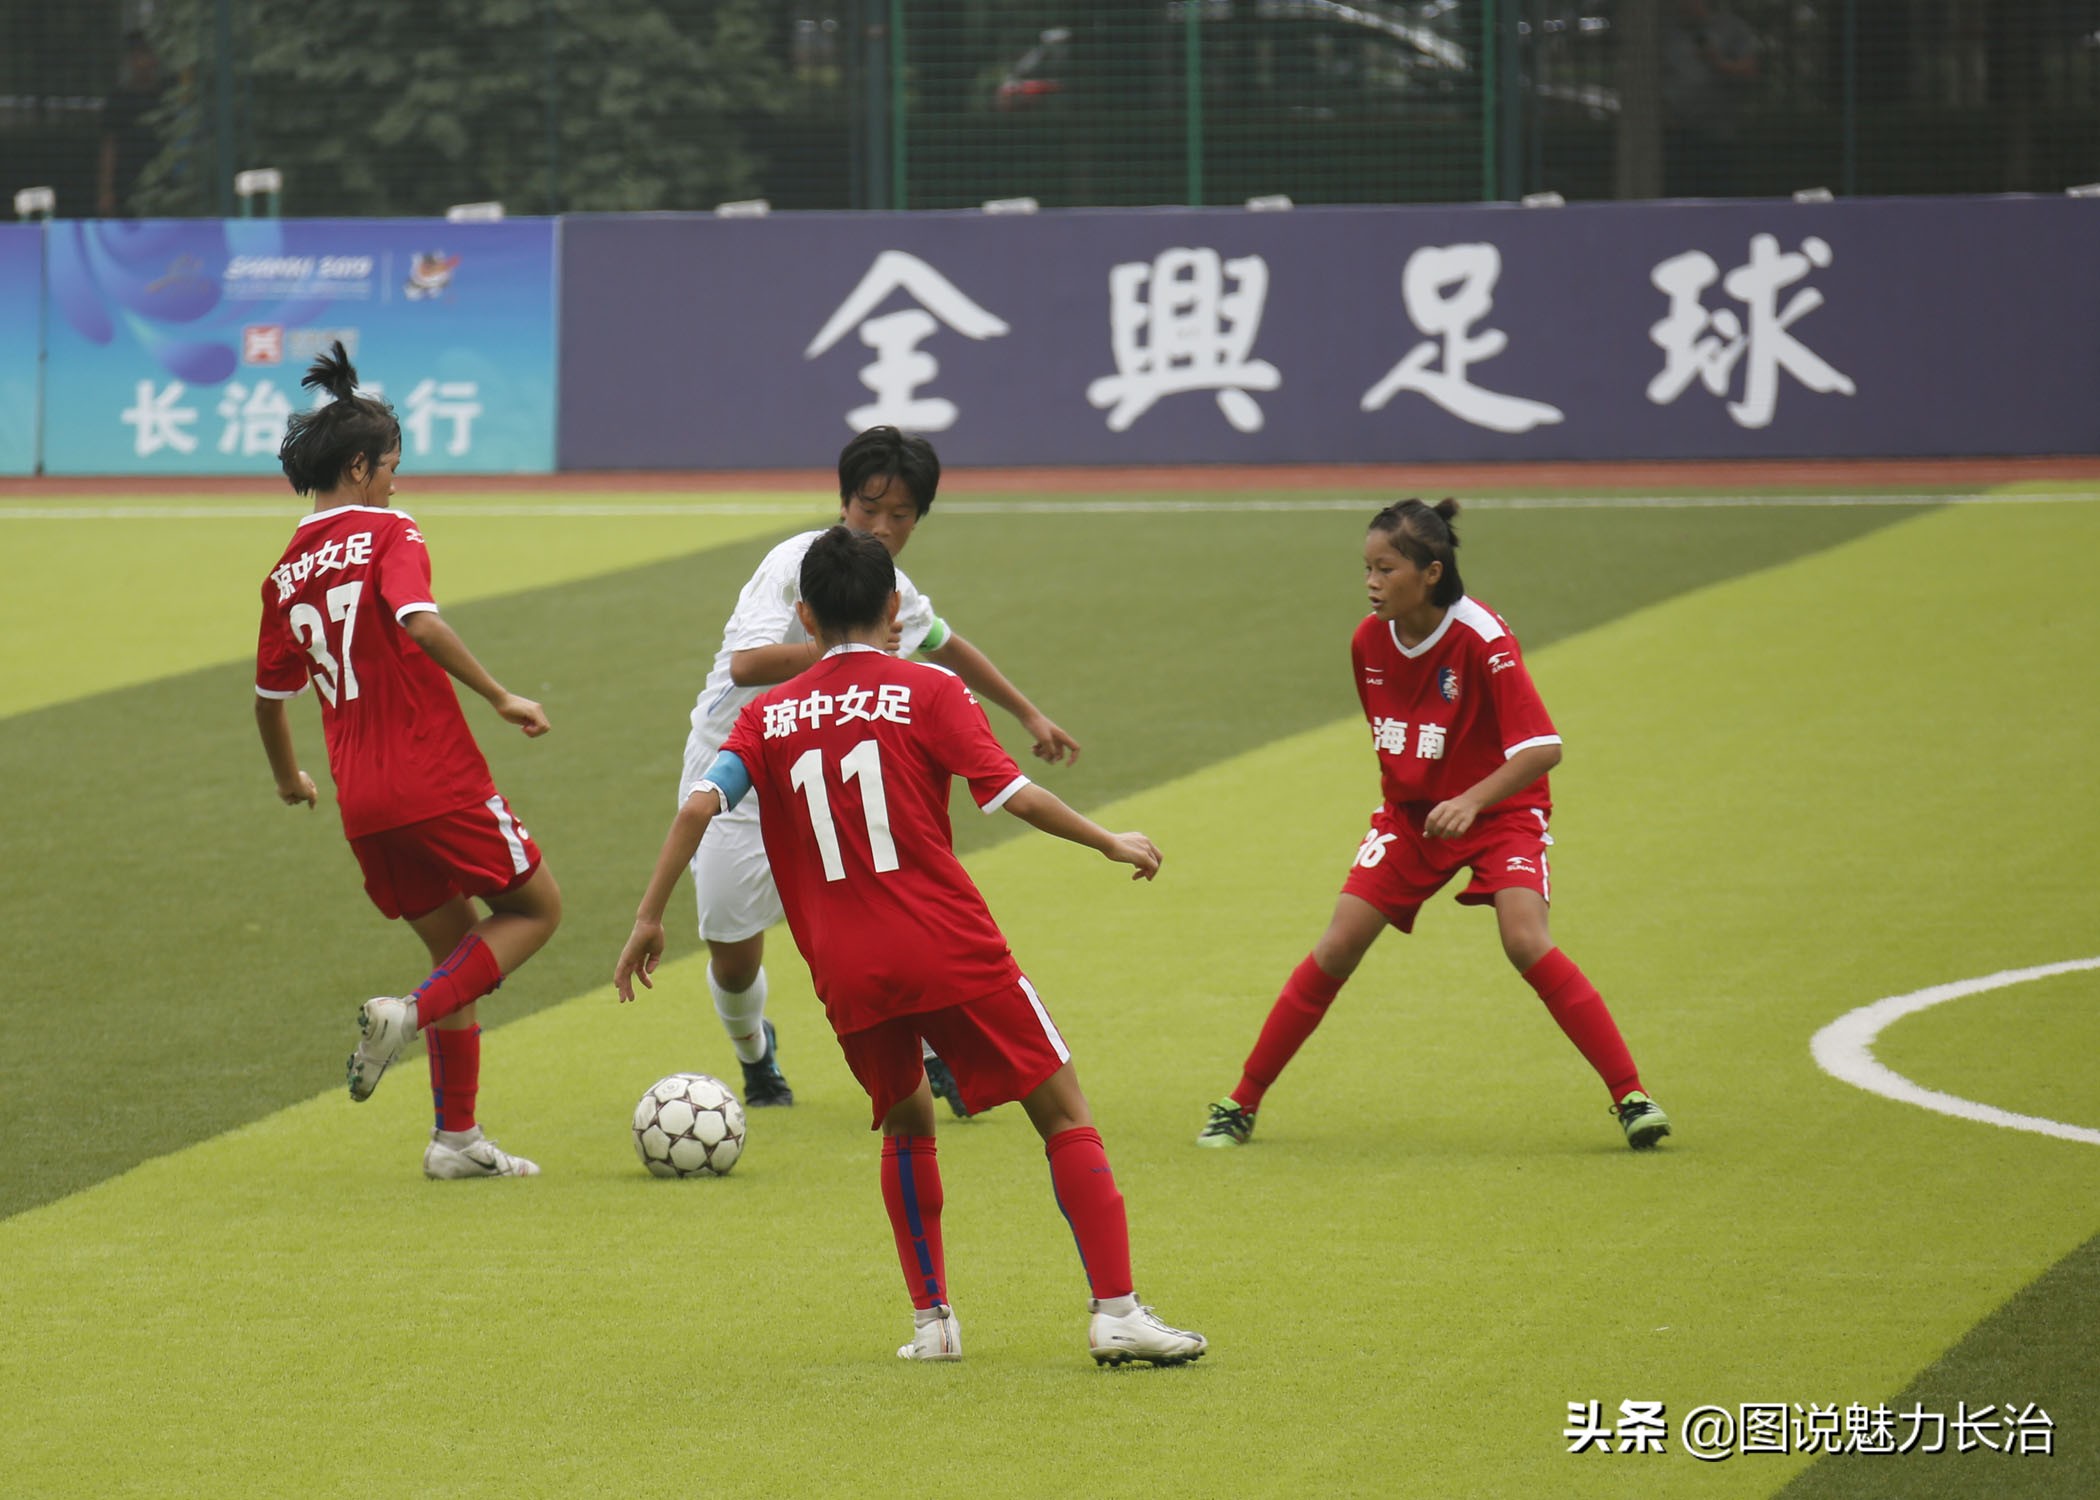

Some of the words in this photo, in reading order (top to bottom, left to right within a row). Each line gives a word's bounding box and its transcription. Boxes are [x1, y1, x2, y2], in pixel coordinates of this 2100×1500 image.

[804, 233, 1856, 432] 全興足球
[122, 380, 482, 458] 长治行
[290, 582, 363, 708] 37
[763, 685, 911, 740] 琼中女足
[1374, 717, 1448, 759] 海南
[790, 740, 900, 882] 11
